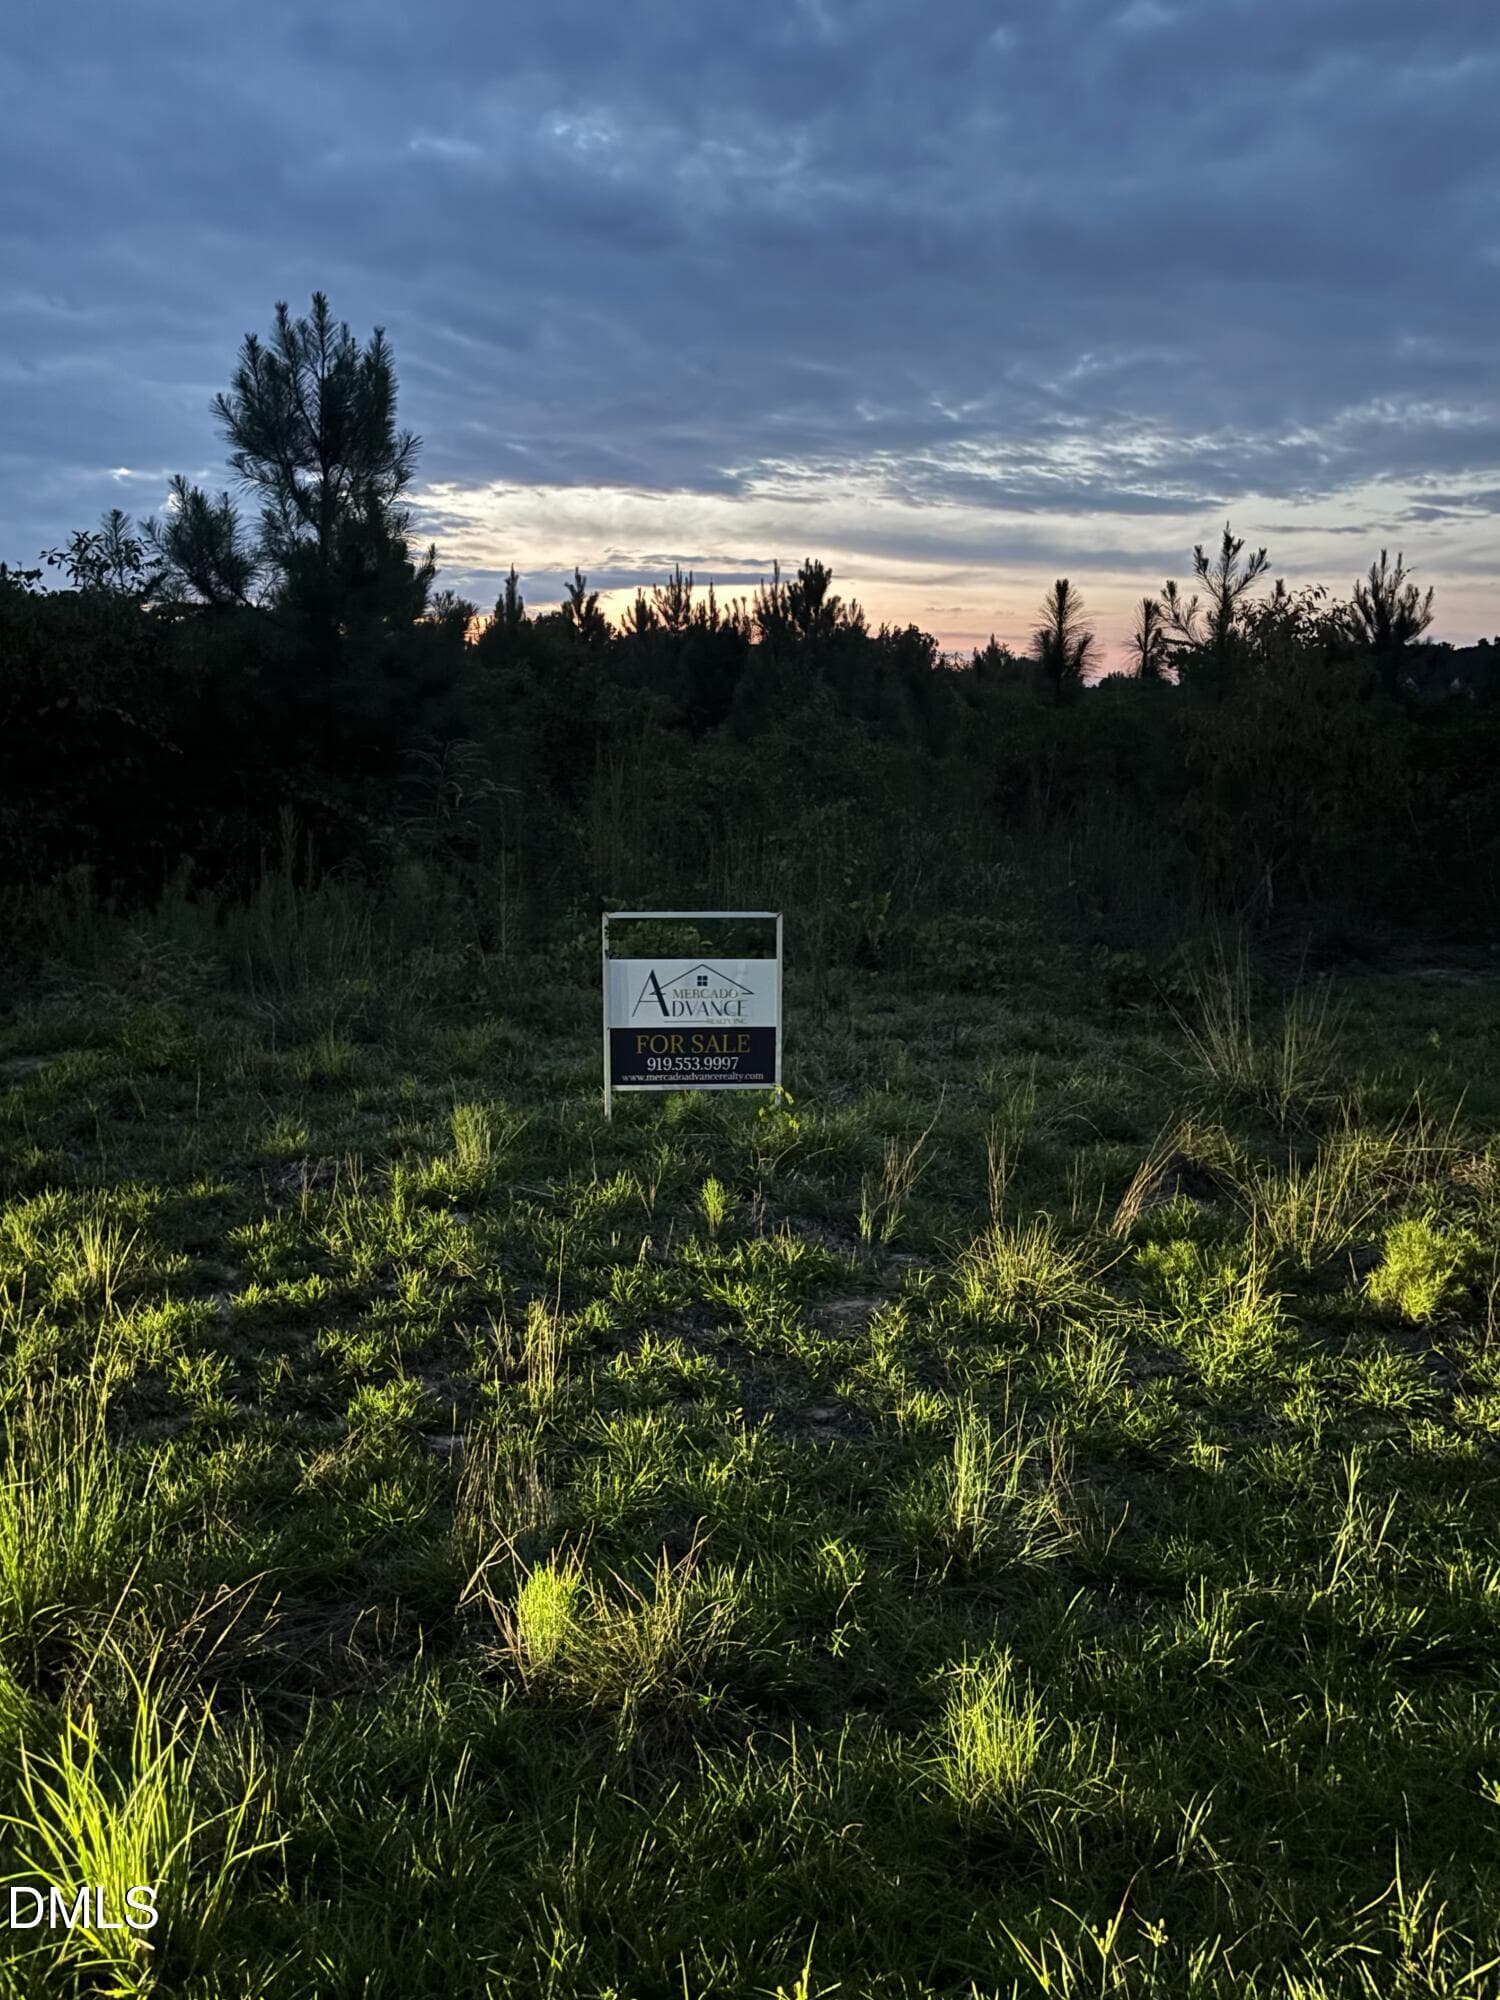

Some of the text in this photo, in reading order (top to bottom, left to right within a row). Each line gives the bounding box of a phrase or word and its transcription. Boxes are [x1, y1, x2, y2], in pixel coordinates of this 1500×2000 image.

[632, 969, 748, 1017] ADVANCE
[673, 988, 738, 999] MERCADO
[636, 1033, 750, 1054] FOR SALE
[647, 1056, 739, 1071] 919.553.9997
[621, 1071, 764, 1082] www.mercadoadvancerealty.com
